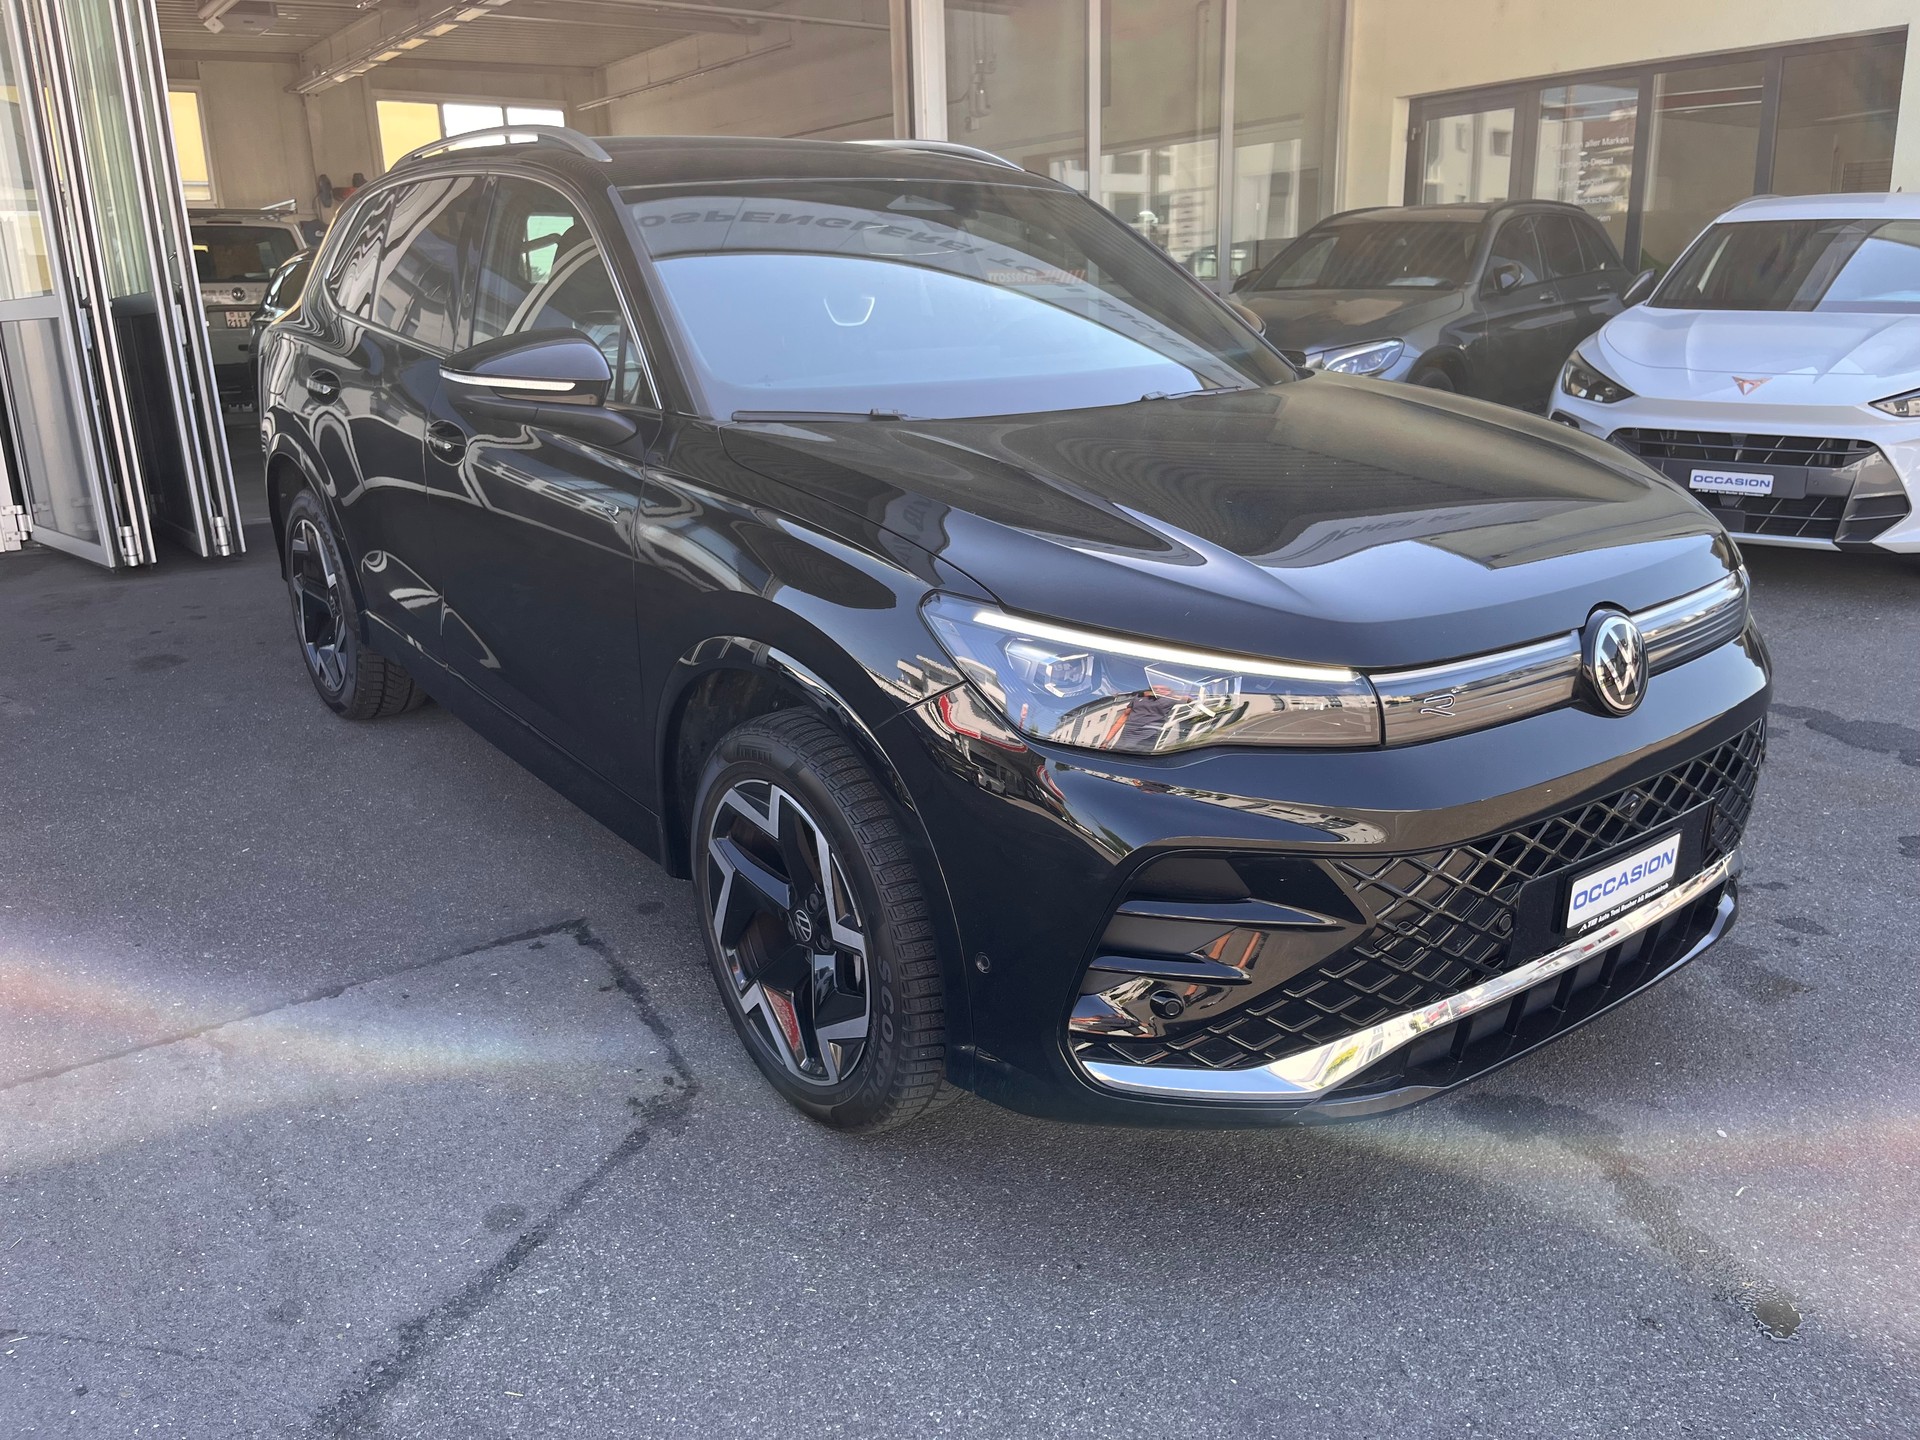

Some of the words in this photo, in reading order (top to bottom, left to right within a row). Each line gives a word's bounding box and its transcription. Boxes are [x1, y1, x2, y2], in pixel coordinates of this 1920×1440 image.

[1602, 136, 1630, 146] Marken
[1693, 475, 1771, 488] OCCASION
[1573, 848, 1675, 911] OCCASION
